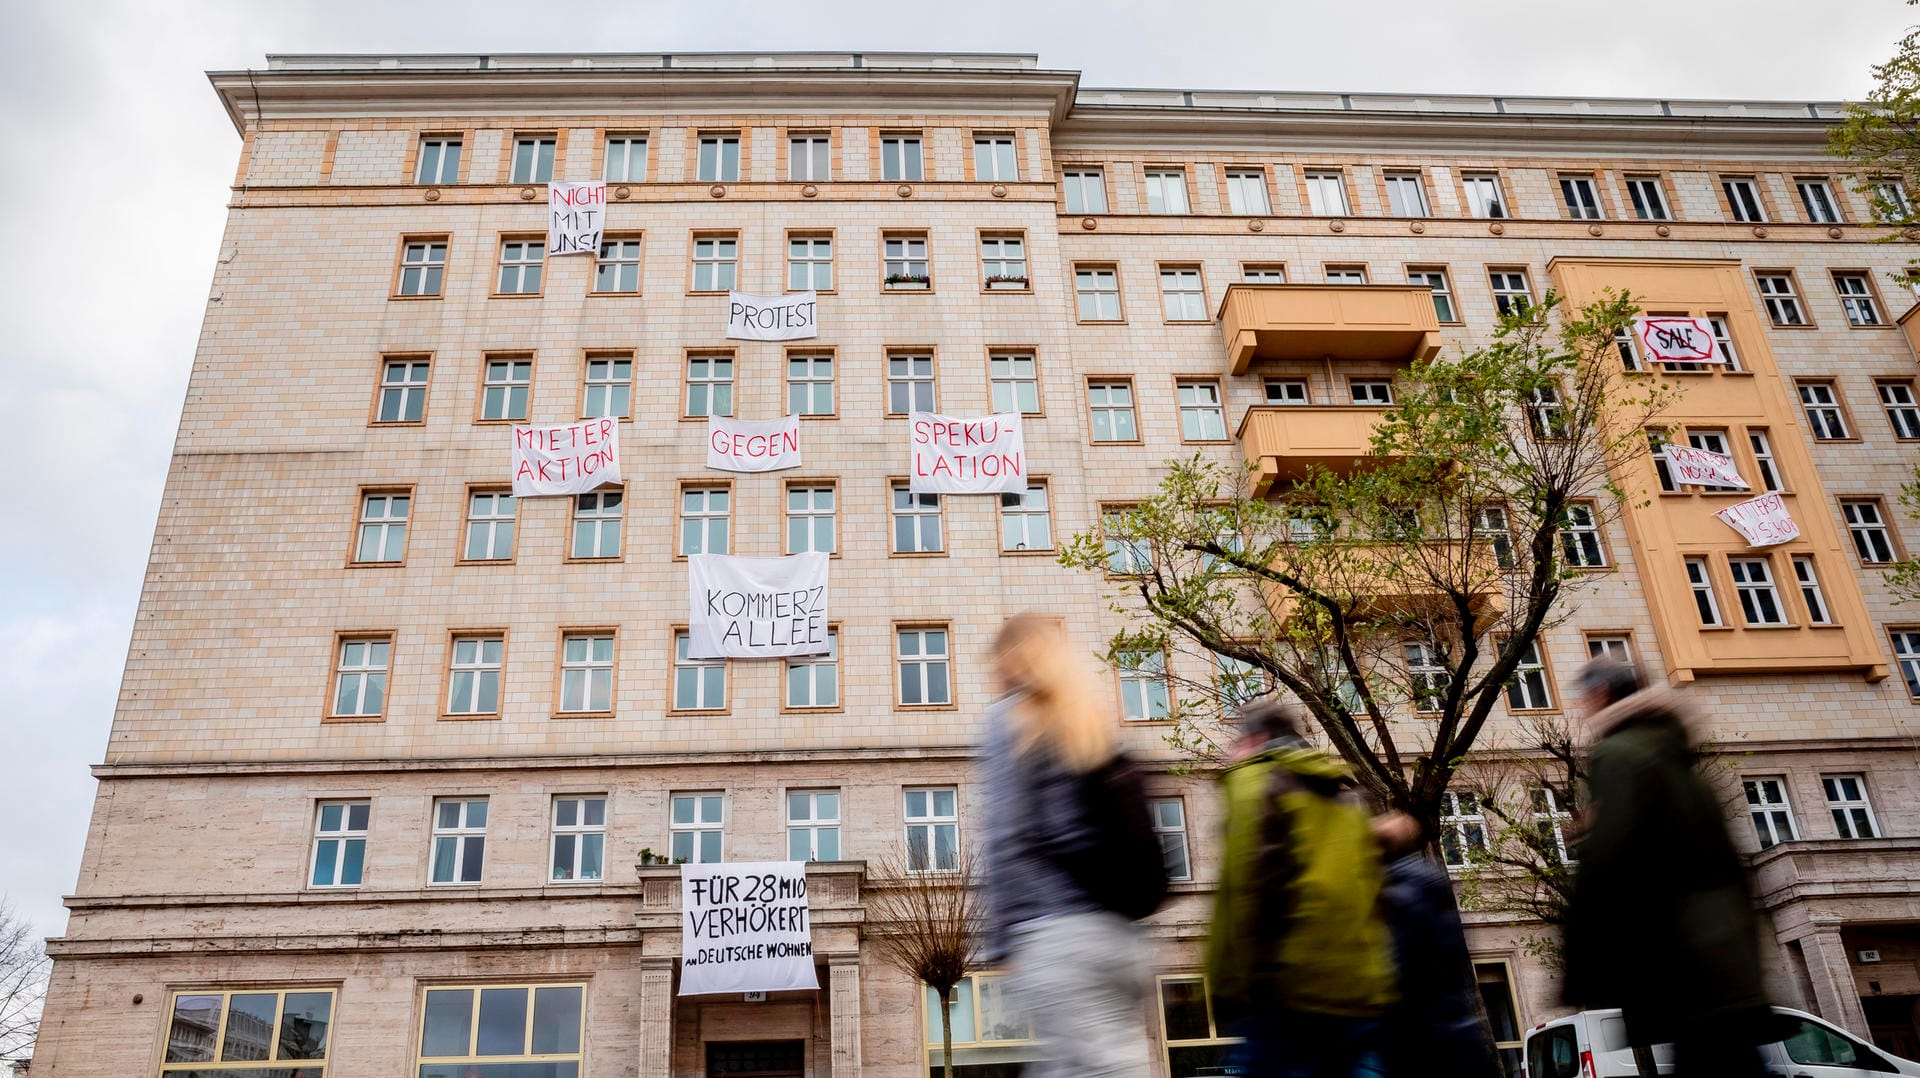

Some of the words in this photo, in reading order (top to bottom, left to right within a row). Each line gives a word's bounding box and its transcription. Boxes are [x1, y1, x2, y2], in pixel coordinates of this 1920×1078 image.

[553, 186, 606, 206] NICHT
[554, 211, 598, 230] MIT
[730, 302, 816, 329] PROTEST
[1655, 328, 1696, 349] SALE
[516, 419, 612, 451] MIETER
[711, 428, 798, 457] GEGEN
[914, 421, 1014, 446] SPEKU-
[516, 443, 614, 482] AKTION
[917, 451, 1020, 478] LATION
[707, 585, 825, 618] KOMMERZ
[721, 615, 823, 647] ALLEE
[689, 875, 740, 906] FÜR
[742, 874, 777, 903] 28
[779, 875, 807, 899] MIO
[689, 903, 808, 939] VERHÖKERT
[685, 957, 698, 967] AN
[698, 944, 764, 965] DEUTSCHE
[766, 941, 812, 959] WOHNEN
